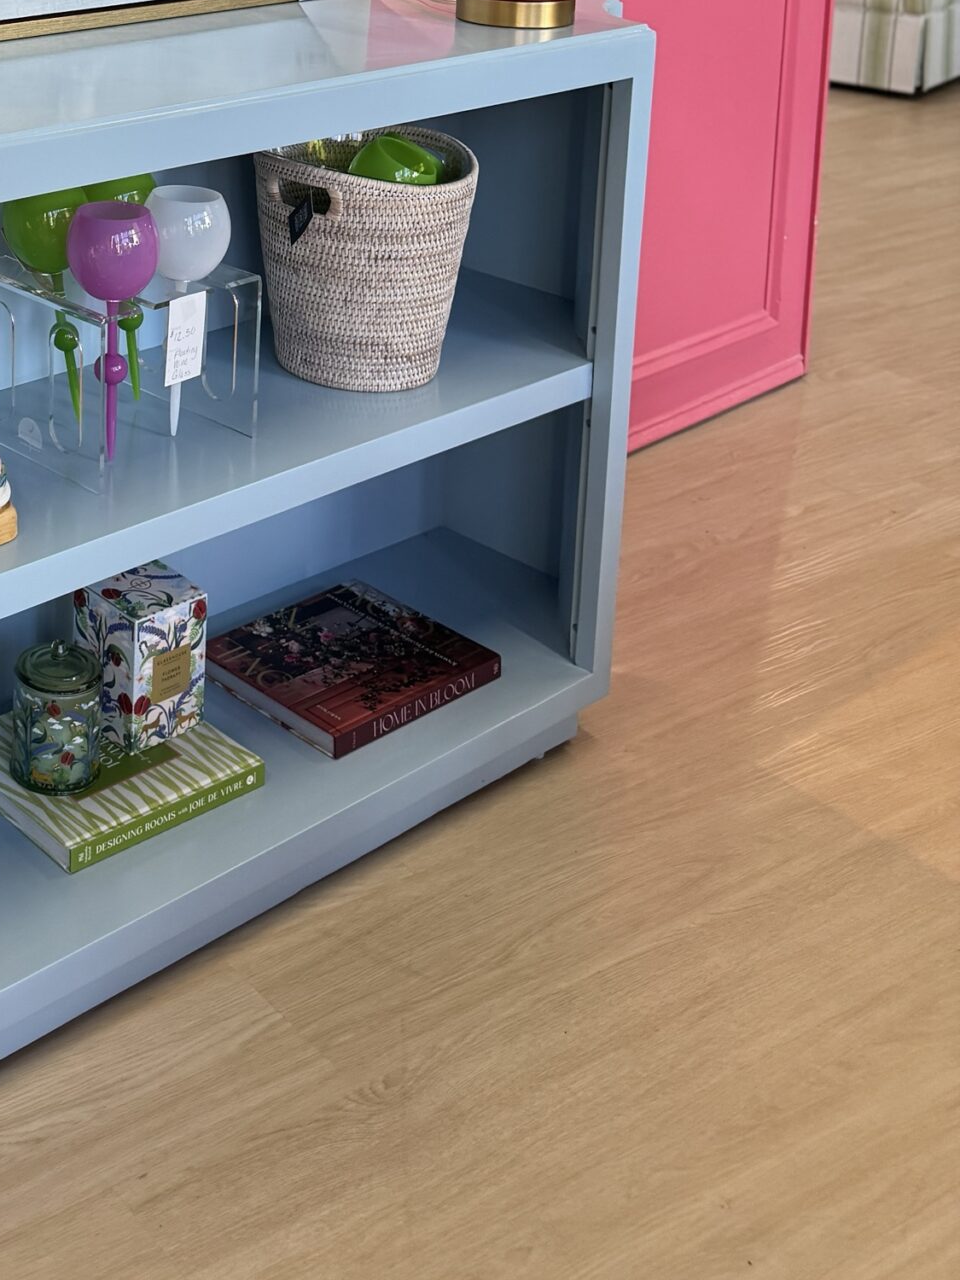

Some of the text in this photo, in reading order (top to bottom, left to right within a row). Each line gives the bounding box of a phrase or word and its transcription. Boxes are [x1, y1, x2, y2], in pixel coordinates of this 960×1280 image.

[373, 703, 413, 737] HOME
[415, 697, 428, 716] IN
[429, 671, 475, 710] BLOOM
[95, 826, 144, 855] DESIGNING
[144, 810, 177, 834] ROOMS
[189, 796, 207, 813] JOIE
[207, 791, 219, 803] DE
[220, 780, 244, 797] VIVRE
